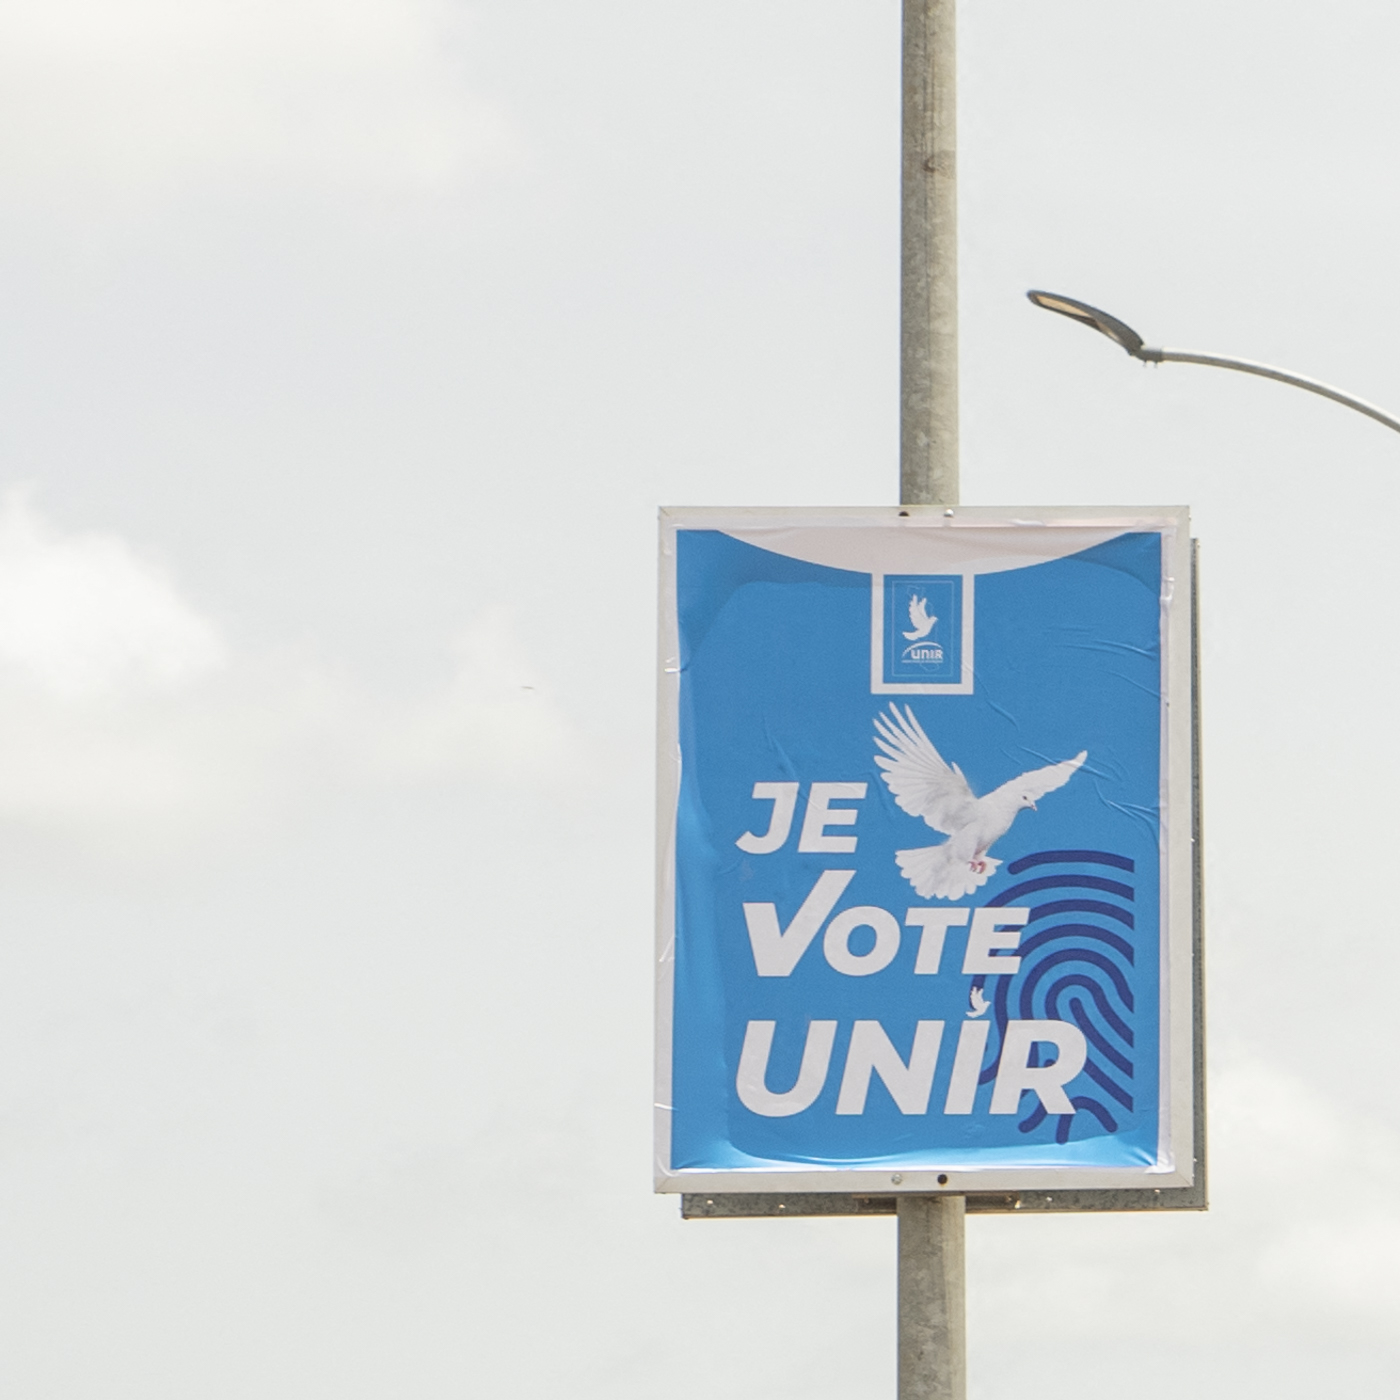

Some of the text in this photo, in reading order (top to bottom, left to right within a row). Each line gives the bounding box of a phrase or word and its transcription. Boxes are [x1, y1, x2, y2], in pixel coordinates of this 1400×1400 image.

[735, 781, 868, 854] JE
[742, 869, 1031, 977] VOTE
[735, 1020, 1088, 1118] UNIR
